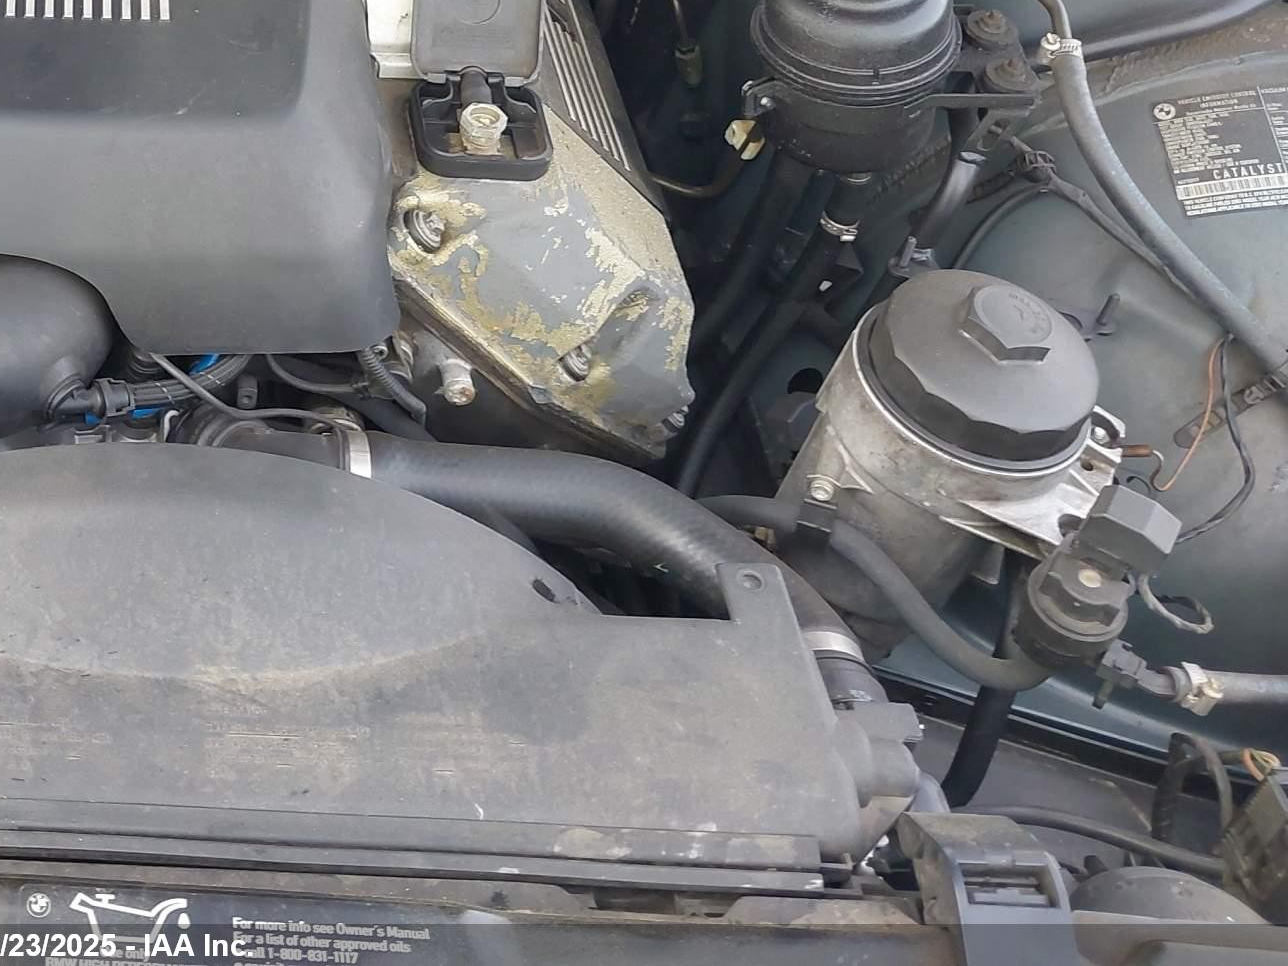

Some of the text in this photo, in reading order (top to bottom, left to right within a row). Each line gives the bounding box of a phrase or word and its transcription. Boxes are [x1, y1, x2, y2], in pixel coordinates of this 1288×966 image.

[1213, 162, 1283, 180] CATALYST
[232, 917, 431, 940] For more info see Owner's Manual
[233, 931, 412, 953] For a list of other approved oils
[267, 947, 360, 964] 1-800-831-1117
